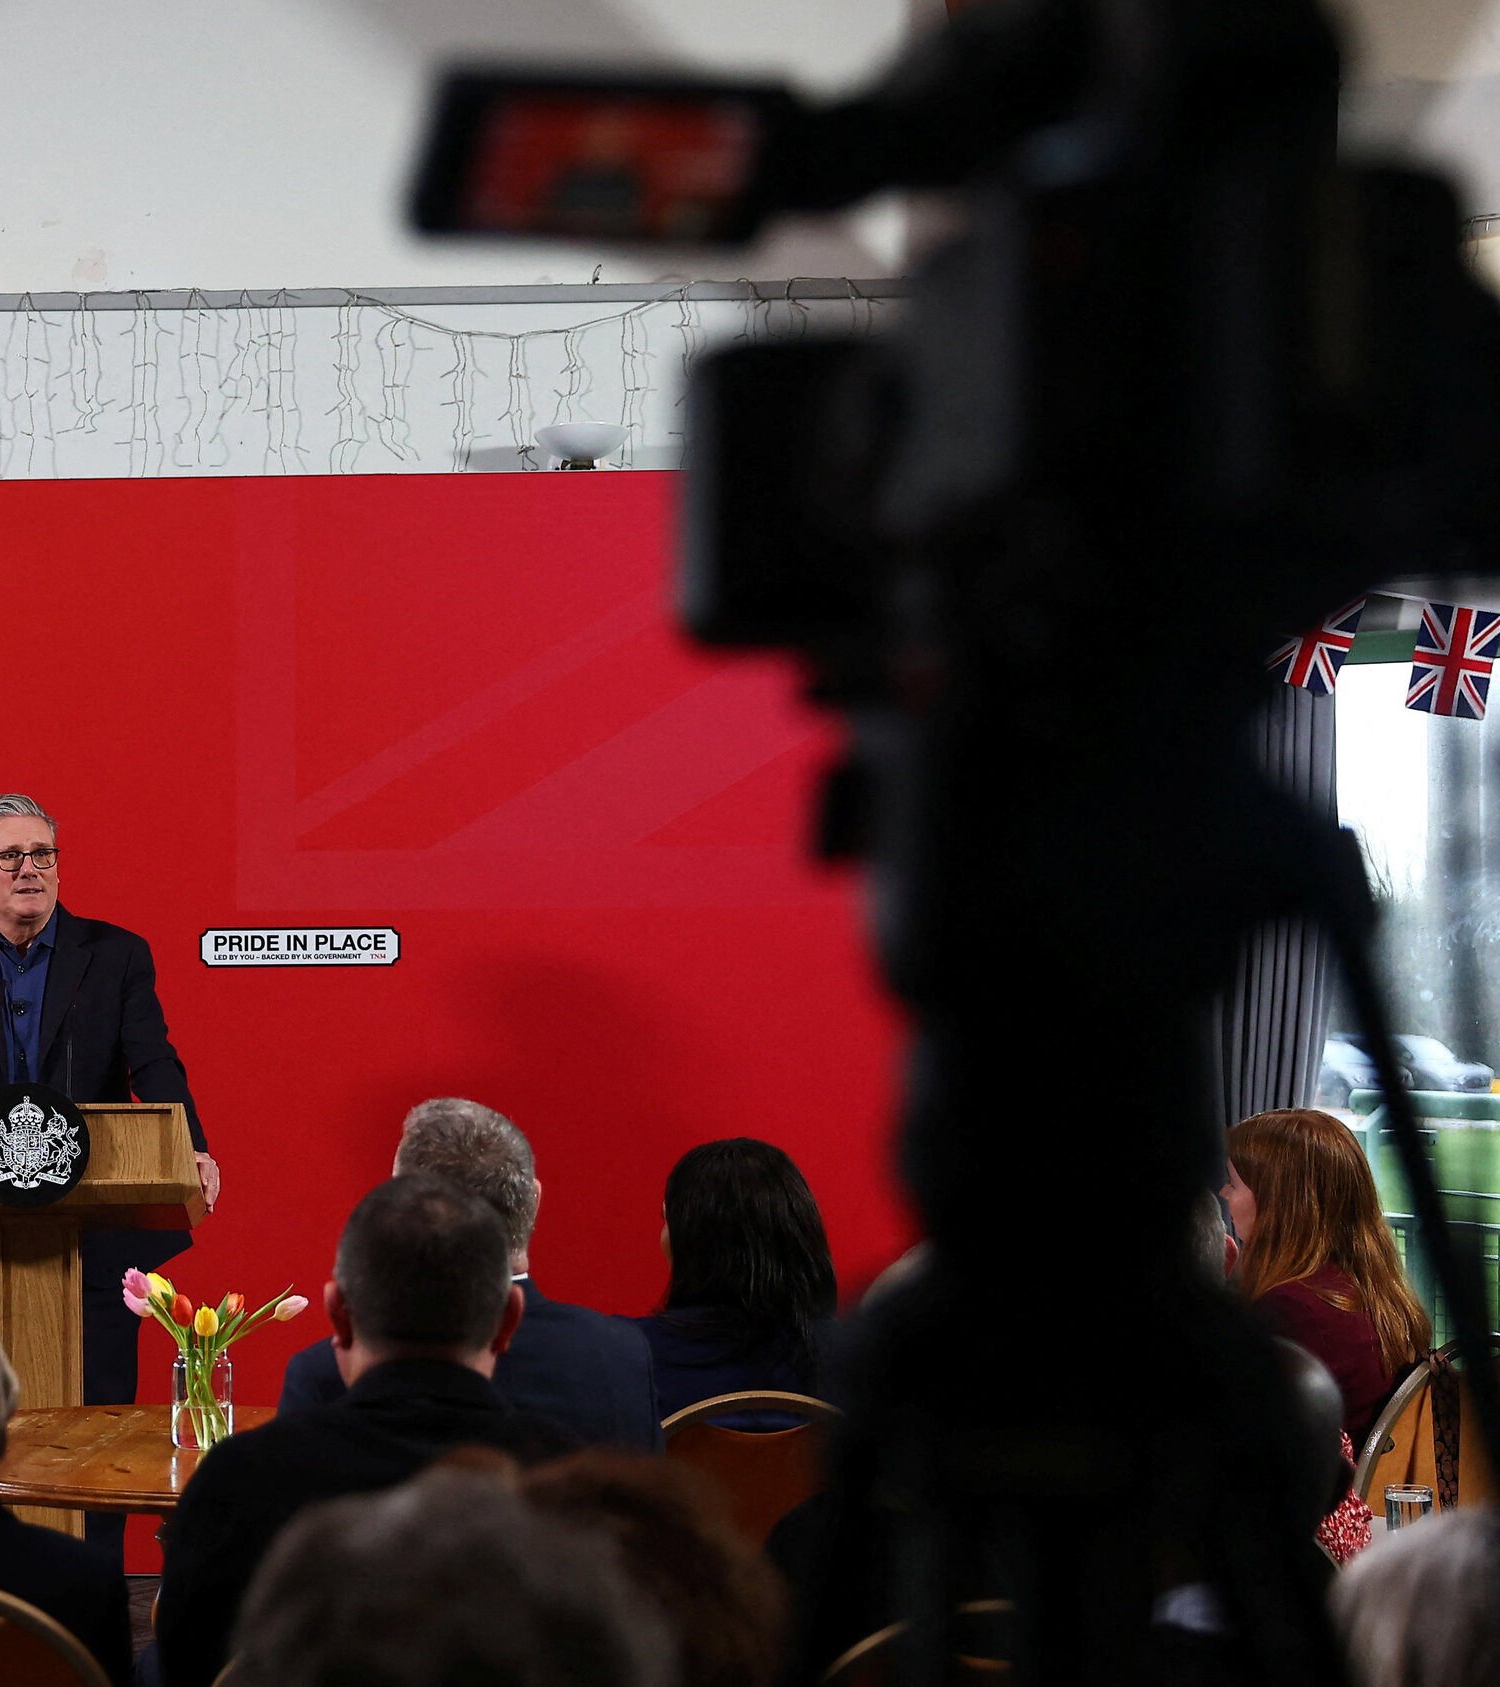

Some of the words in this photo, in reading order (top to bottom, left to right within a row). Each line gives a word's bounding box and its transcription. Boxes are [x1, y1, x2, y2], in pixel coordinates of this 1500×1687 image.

[214, 935, 279, 952] PRIDE
[286, 934, 308, 951] IN
[315, 933, 387, 951] PLACE
